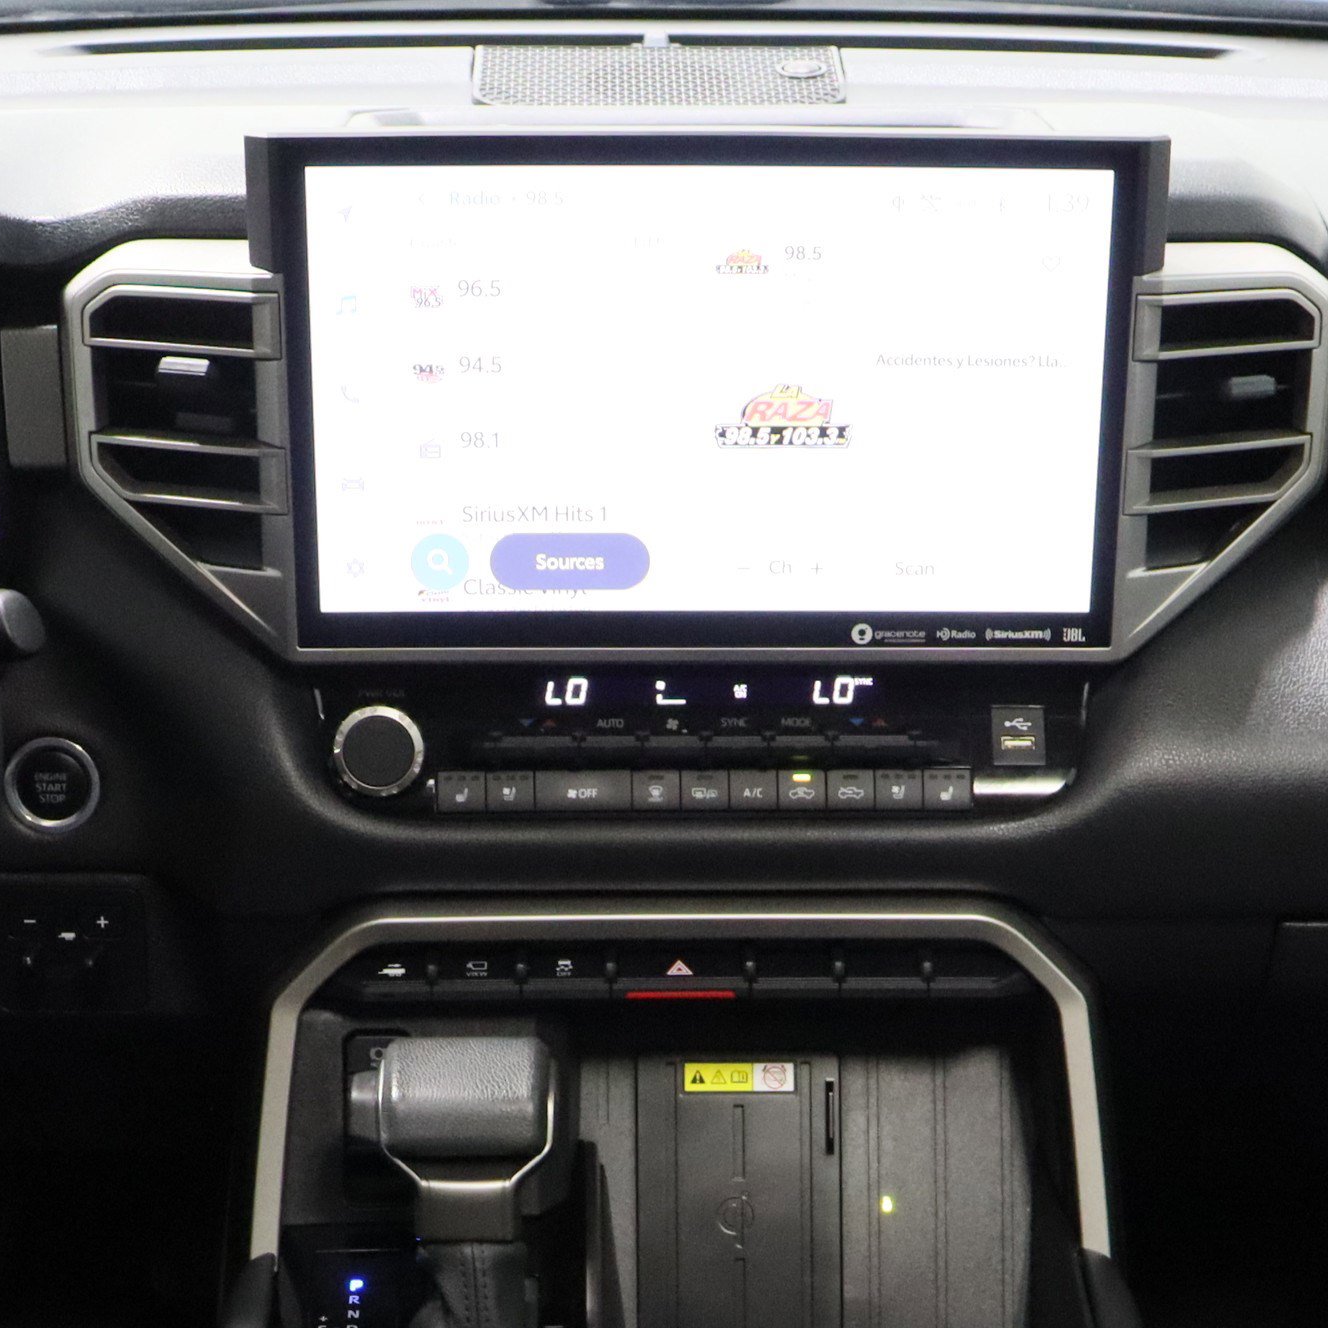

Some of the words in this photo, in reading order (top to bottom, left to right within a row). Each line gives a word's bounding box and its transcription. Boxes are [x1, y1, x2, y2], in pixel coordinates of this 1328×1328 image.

[784, 245, 822, 261] 98.5
[457, 279, 502, 298] 96.5
[458, 355, 502, 374] 94.5
[744, 400, 833, 423] RAZA
[460, 431, 500, 449] 98.1
[462, 505, 549, 524] SiriusXM
[554, 505, 594, 523] Hits
[600, 505, 608, 523] 1
[534, 552, 606, 572] Sources
[895, 560, 936, 576] Scan
[950, 629, 977, 640] Radio
[1063, 627, 1087, 643] JBL
[544, 676, 590, 707] LO
[811, 675, 855, 706] LO
[596, 718, 625, 729] AUTO
[720, 716, 748, 728] SYNC
[35, 782, 67, 792] START
[578, 788, 598, 799] OFF
[743, 787, 764, 799] A/C
[39, 793, 66, 804] STOP
[349, 1278, 365, 1292] P
[348, 1294, 361, 1305] R
[347, 1309, 361, 1319] N
